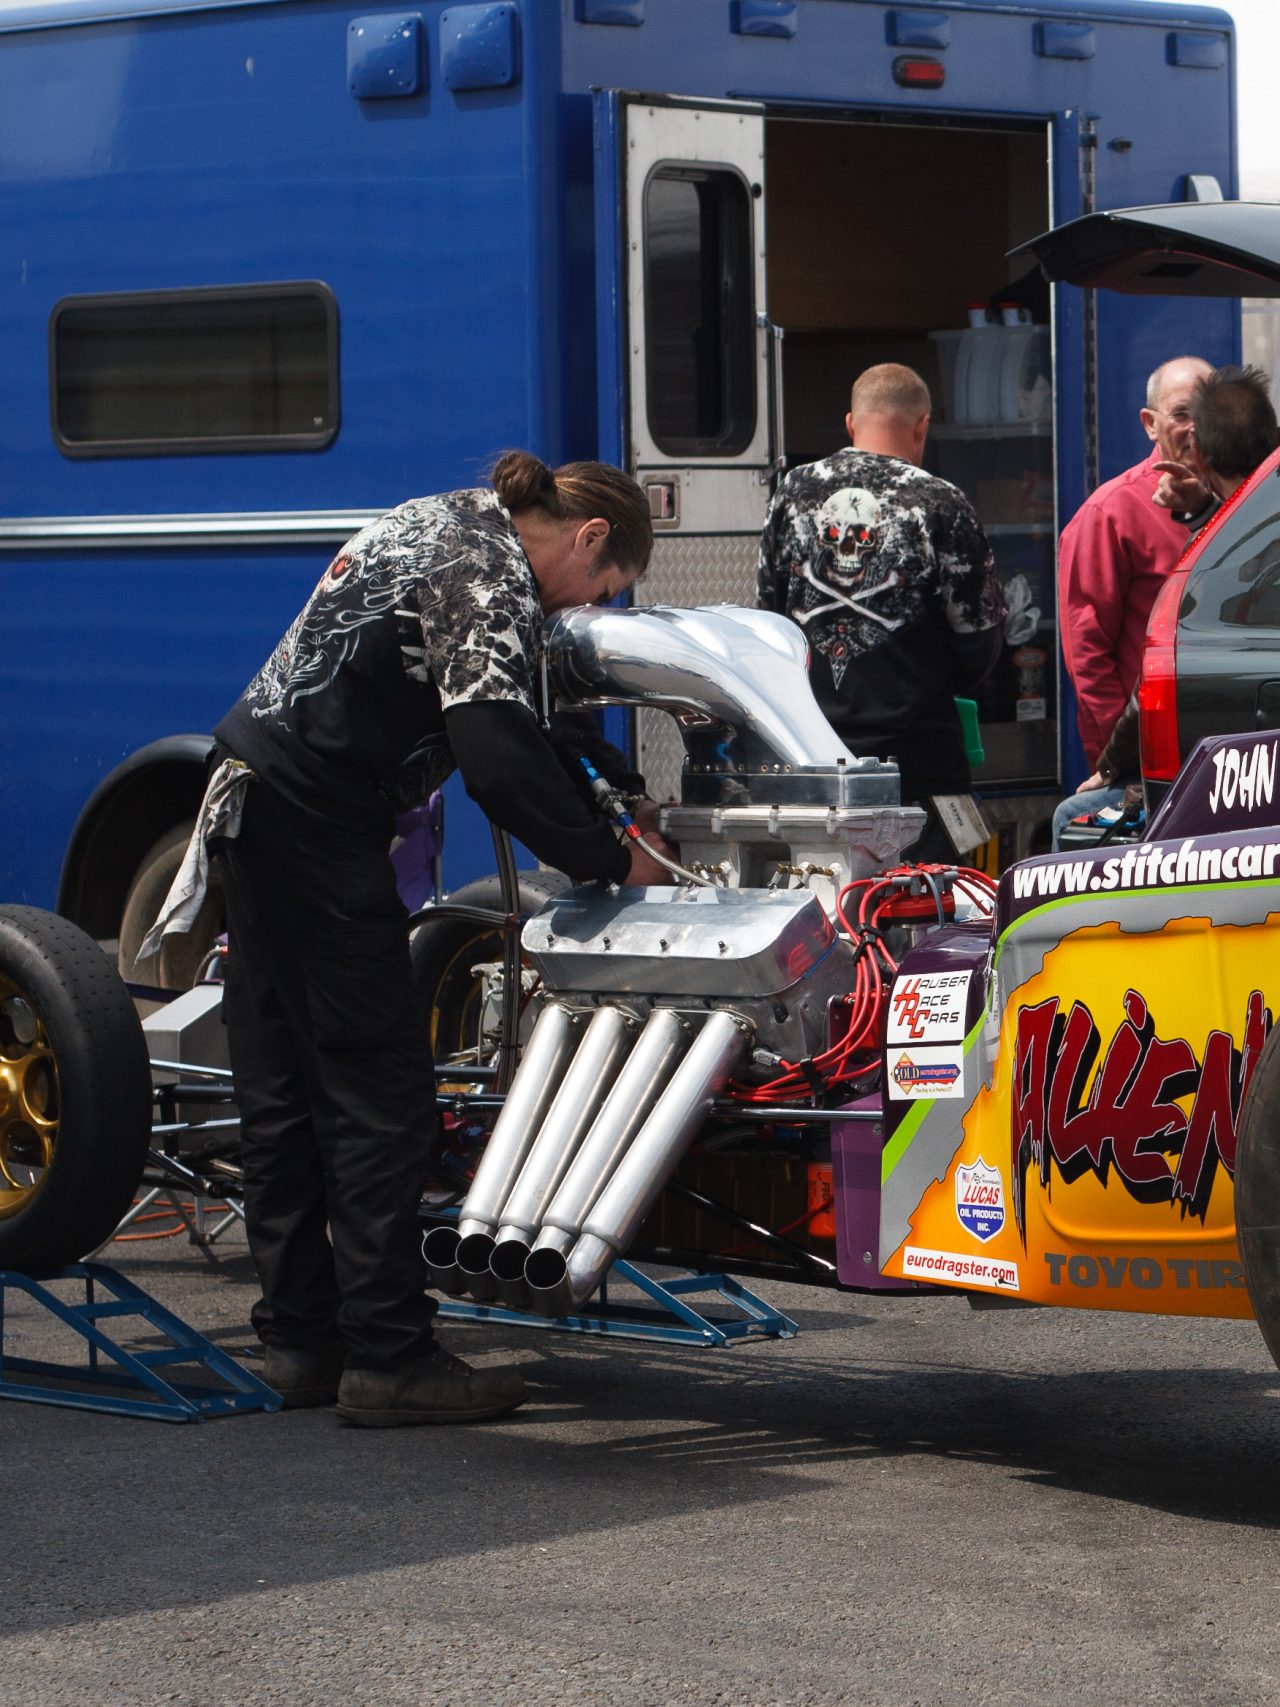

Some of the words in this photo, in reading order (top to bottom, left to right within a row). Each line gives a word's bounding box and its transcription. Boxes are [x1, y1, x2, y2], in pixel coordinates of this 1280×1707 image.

[1209, 740, 1278, 815] JOHN
[901, 975, 969, 996] HAUSER
[893, 993, 951, 1026] RACE
[909, 1010, 960, 1038] CARS
[963, 1184, 1000, 1205] LUCAS
[960, 1208, 971, 1218] OIL
[977, 1222, 990, 1232] INC.
[906, 1254, 1015, 1282] eurodragster.com
[1044, 1252, 1163, 1289] TOYO
[1167, 1257, 1246, 1290] TIR
